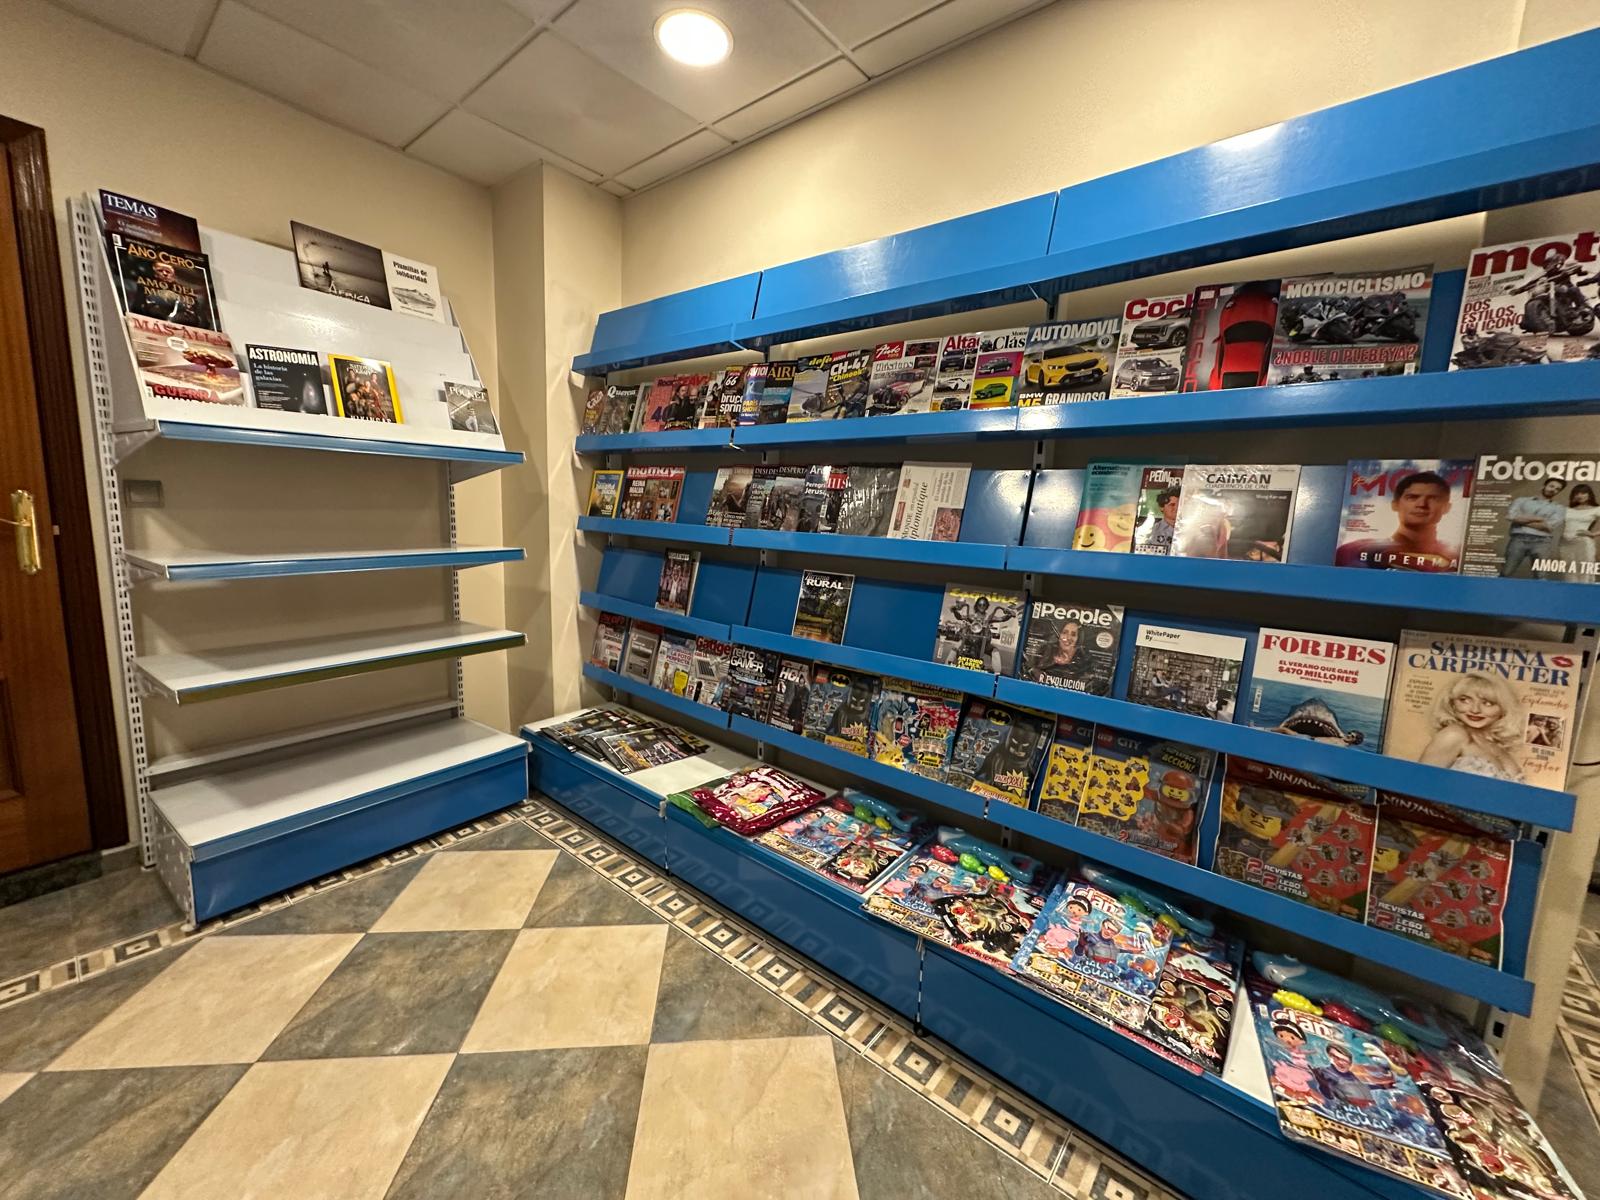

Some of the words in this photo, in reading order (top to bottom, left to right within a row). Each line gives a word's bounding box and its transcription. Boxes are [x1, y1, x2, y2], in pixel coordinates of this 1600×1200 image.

[103, 193, 158, 219] TEMAS
[159, 251, 195, 270] CERO
[1469, 231, 1600, 278] mot
[1286, 272, 1426, 299] MOTOCICLISMO
[1464, 298, 1491, 314] DOS
[944, 335, 980, 351] Alta
[830, 355, 870, 375] CH-47
[153, 383, 220, 402] GUERRA
[1045, 391, 1107, 406] GRANDIOSO
[1531, 559, 1568, 573] AMOR
[1568, 560, 1577, 573] A
[806, 579, 844, 590] RURAL
[1041, 602, 1113, 626] People
[1146, 629, 1181, 640] WhitePaper
[695, 636, 732, 656] Gadge
[732, 647, 756, 660] retro
[1262, 634, 1387, 665] FORBES
[1430, 640, 1548, 668] SABRINA
[730, 655, 764, 673] GAMER
[1288, 661, 1320, 670] VERANO
[1337, 669, 1360, 677] GANÉ
[1407, 652, 1571, 687] CARPENTER
[1278, 665, 1303, 676] $470
[1304, 670, 1359, 684] MILLONES
[1117, 737, 1142, 750] CITY
[1263, 864, 1304, 881] REVISTAS
[1277, 884, 1308, 899] EXTRAS
[1278, 878, 1301, 889] LEGO
[1378, 900, 1425, 920] REVISTAS
[1394, 923, 1432, 940] EXTRAS
[1396, 917, 1423, 931] LEGO
